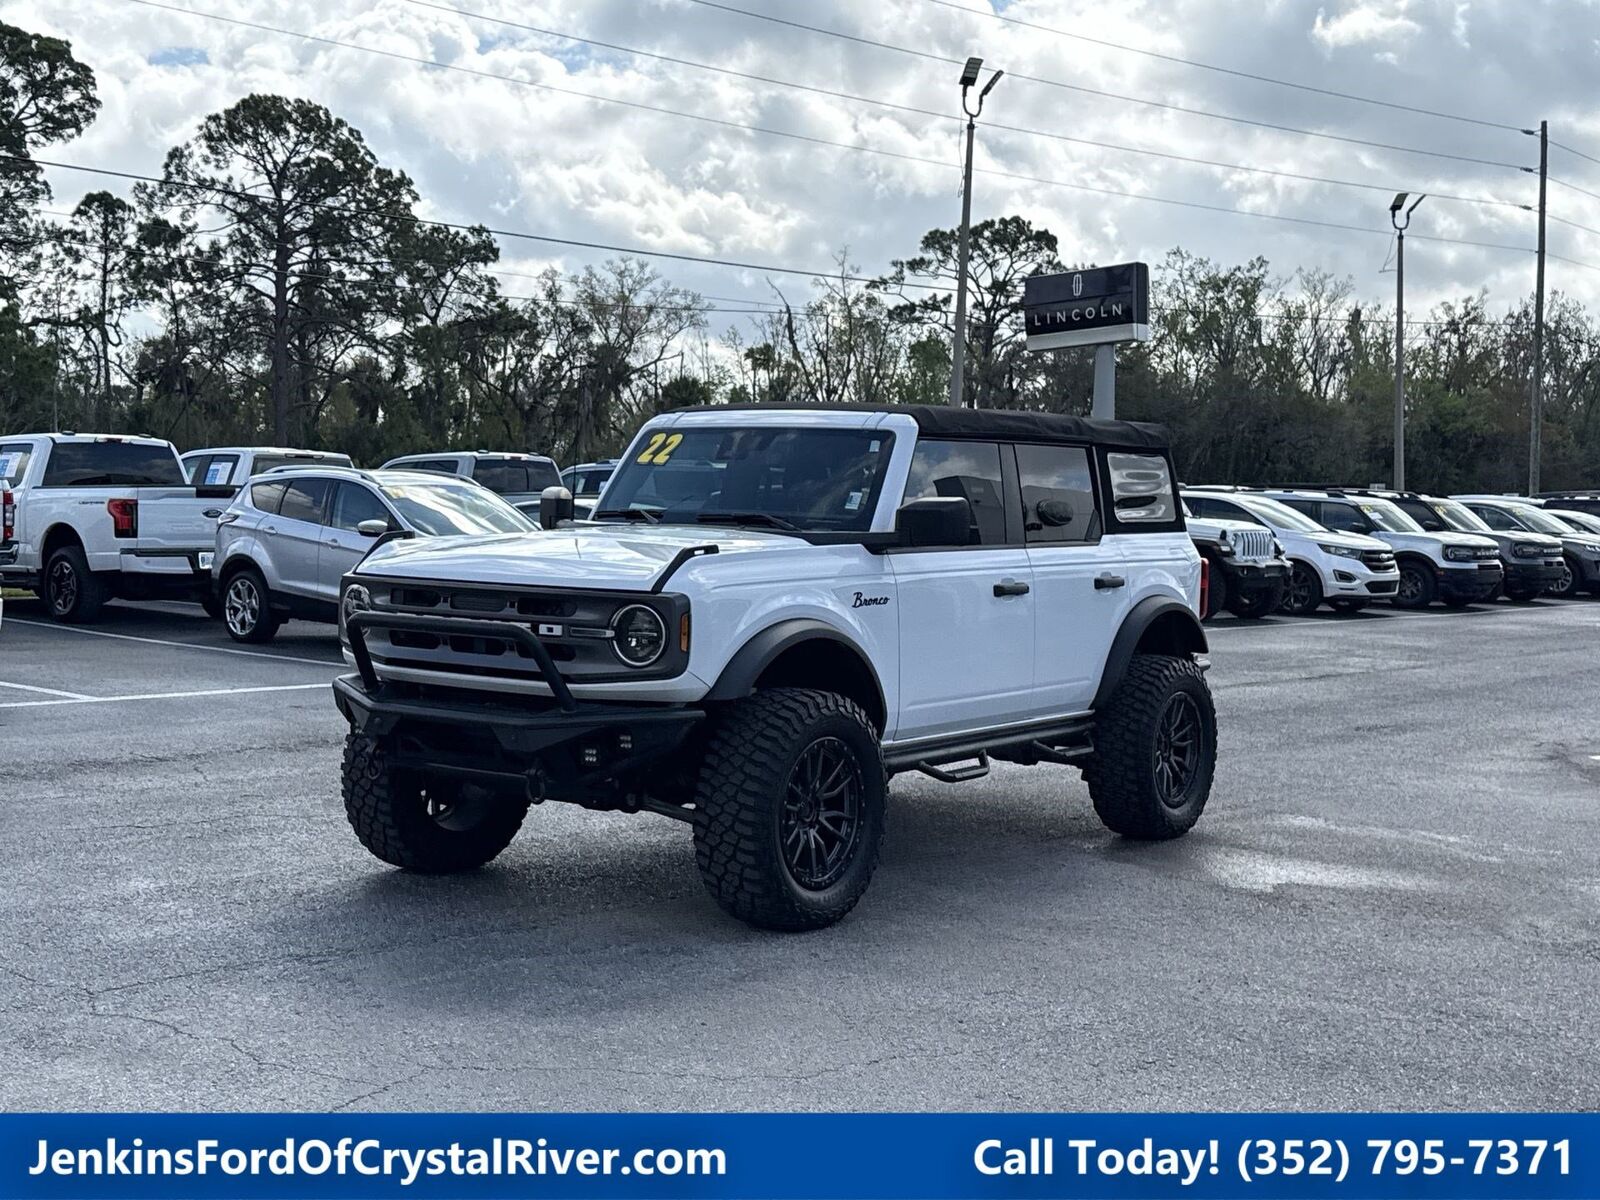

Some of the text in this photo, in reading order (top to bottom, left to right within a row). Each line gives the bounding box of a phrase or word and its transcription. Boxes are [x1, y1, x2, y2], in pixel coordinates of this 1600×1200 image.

[1034, 303, 1122, 326] LINCOLN
[637, 432, 684, 466] 22
[851, 591, 891, 608] Bronco
